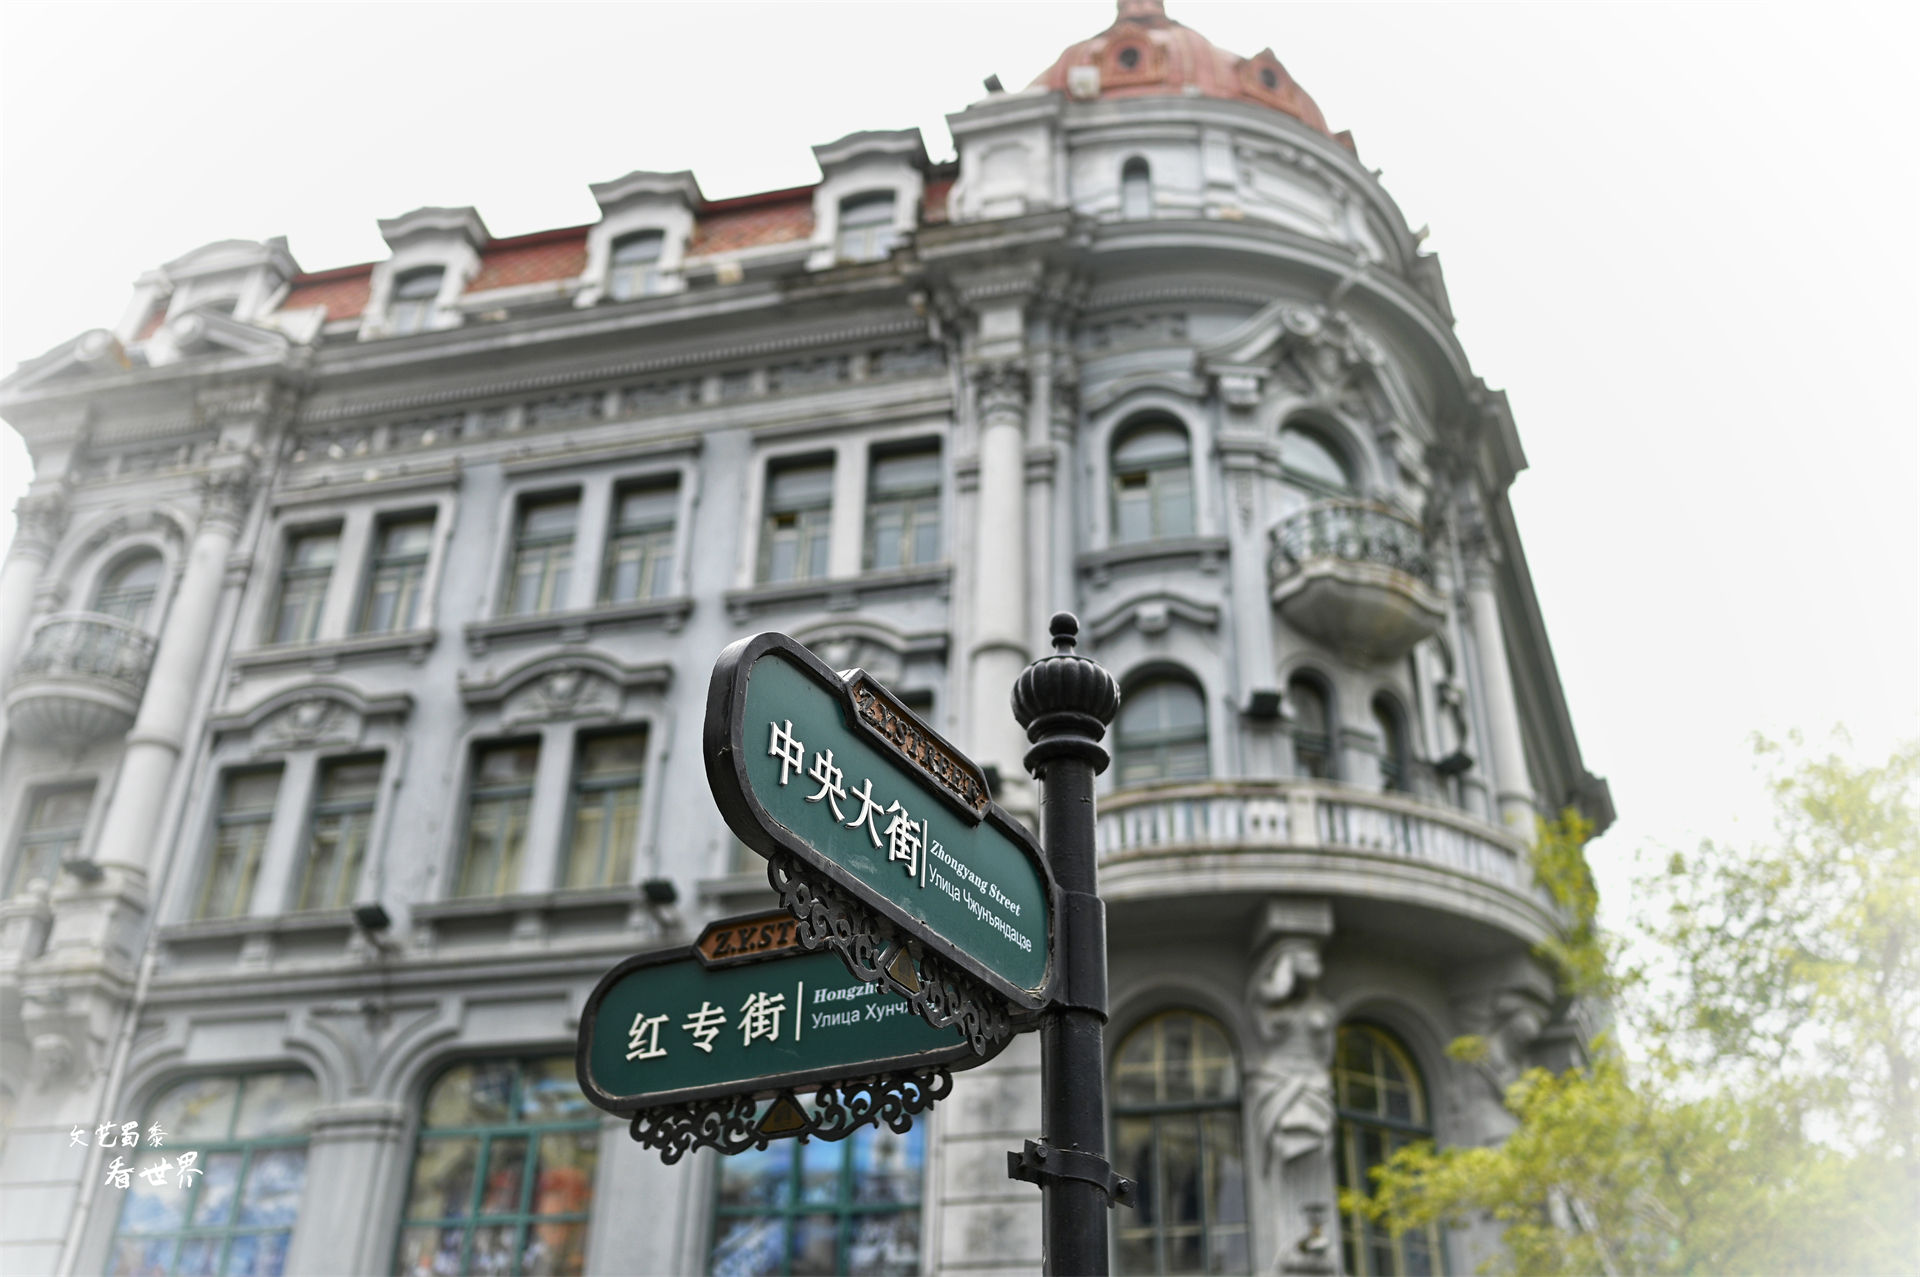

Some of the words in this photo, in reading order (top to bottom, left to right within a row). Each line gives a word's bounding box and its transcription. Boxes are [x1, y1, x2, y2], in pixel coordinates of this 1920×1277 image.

[768, 719, 922, 877] 中央大街
[929, 864, 961, 902] Улица
[963, 888, 1032, 952] Чжунъяндацзе
[930, 840, 988, 894] Zhongyang
[989, 884, 1021, 916] Street
[713, 920, 799, 957] Z.Y.ST
[625, 991, 787, 1062] 红专街
[811, 1009, 860, 1029] Улица
